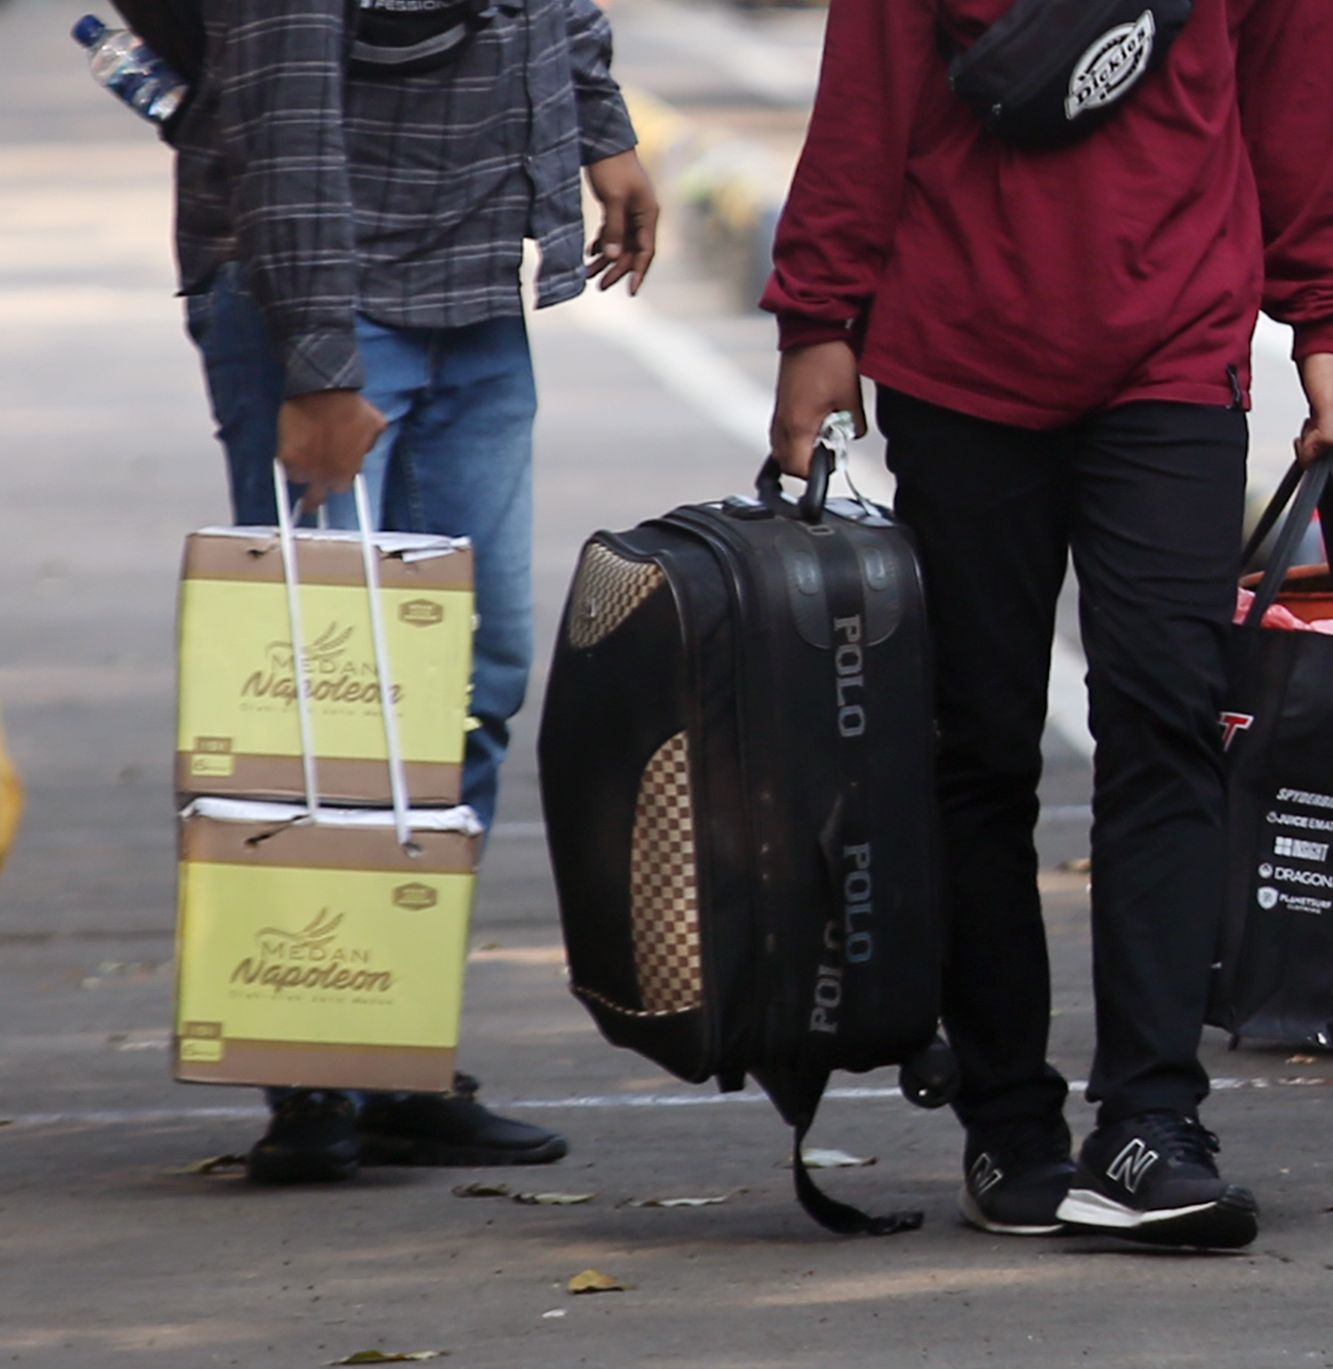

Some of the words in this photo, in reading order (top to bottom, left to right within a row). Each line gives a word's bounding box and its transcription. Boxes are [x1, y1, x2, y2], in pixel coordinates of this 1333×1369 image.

[833, 614, 866, 738] POLO
[844, 842, 873, 963] POLO
[229, 956, 395, 995] Napoleon
[261, 941, 370, 964] MEDAN
[1106, 1136, 1159, 1194] N
